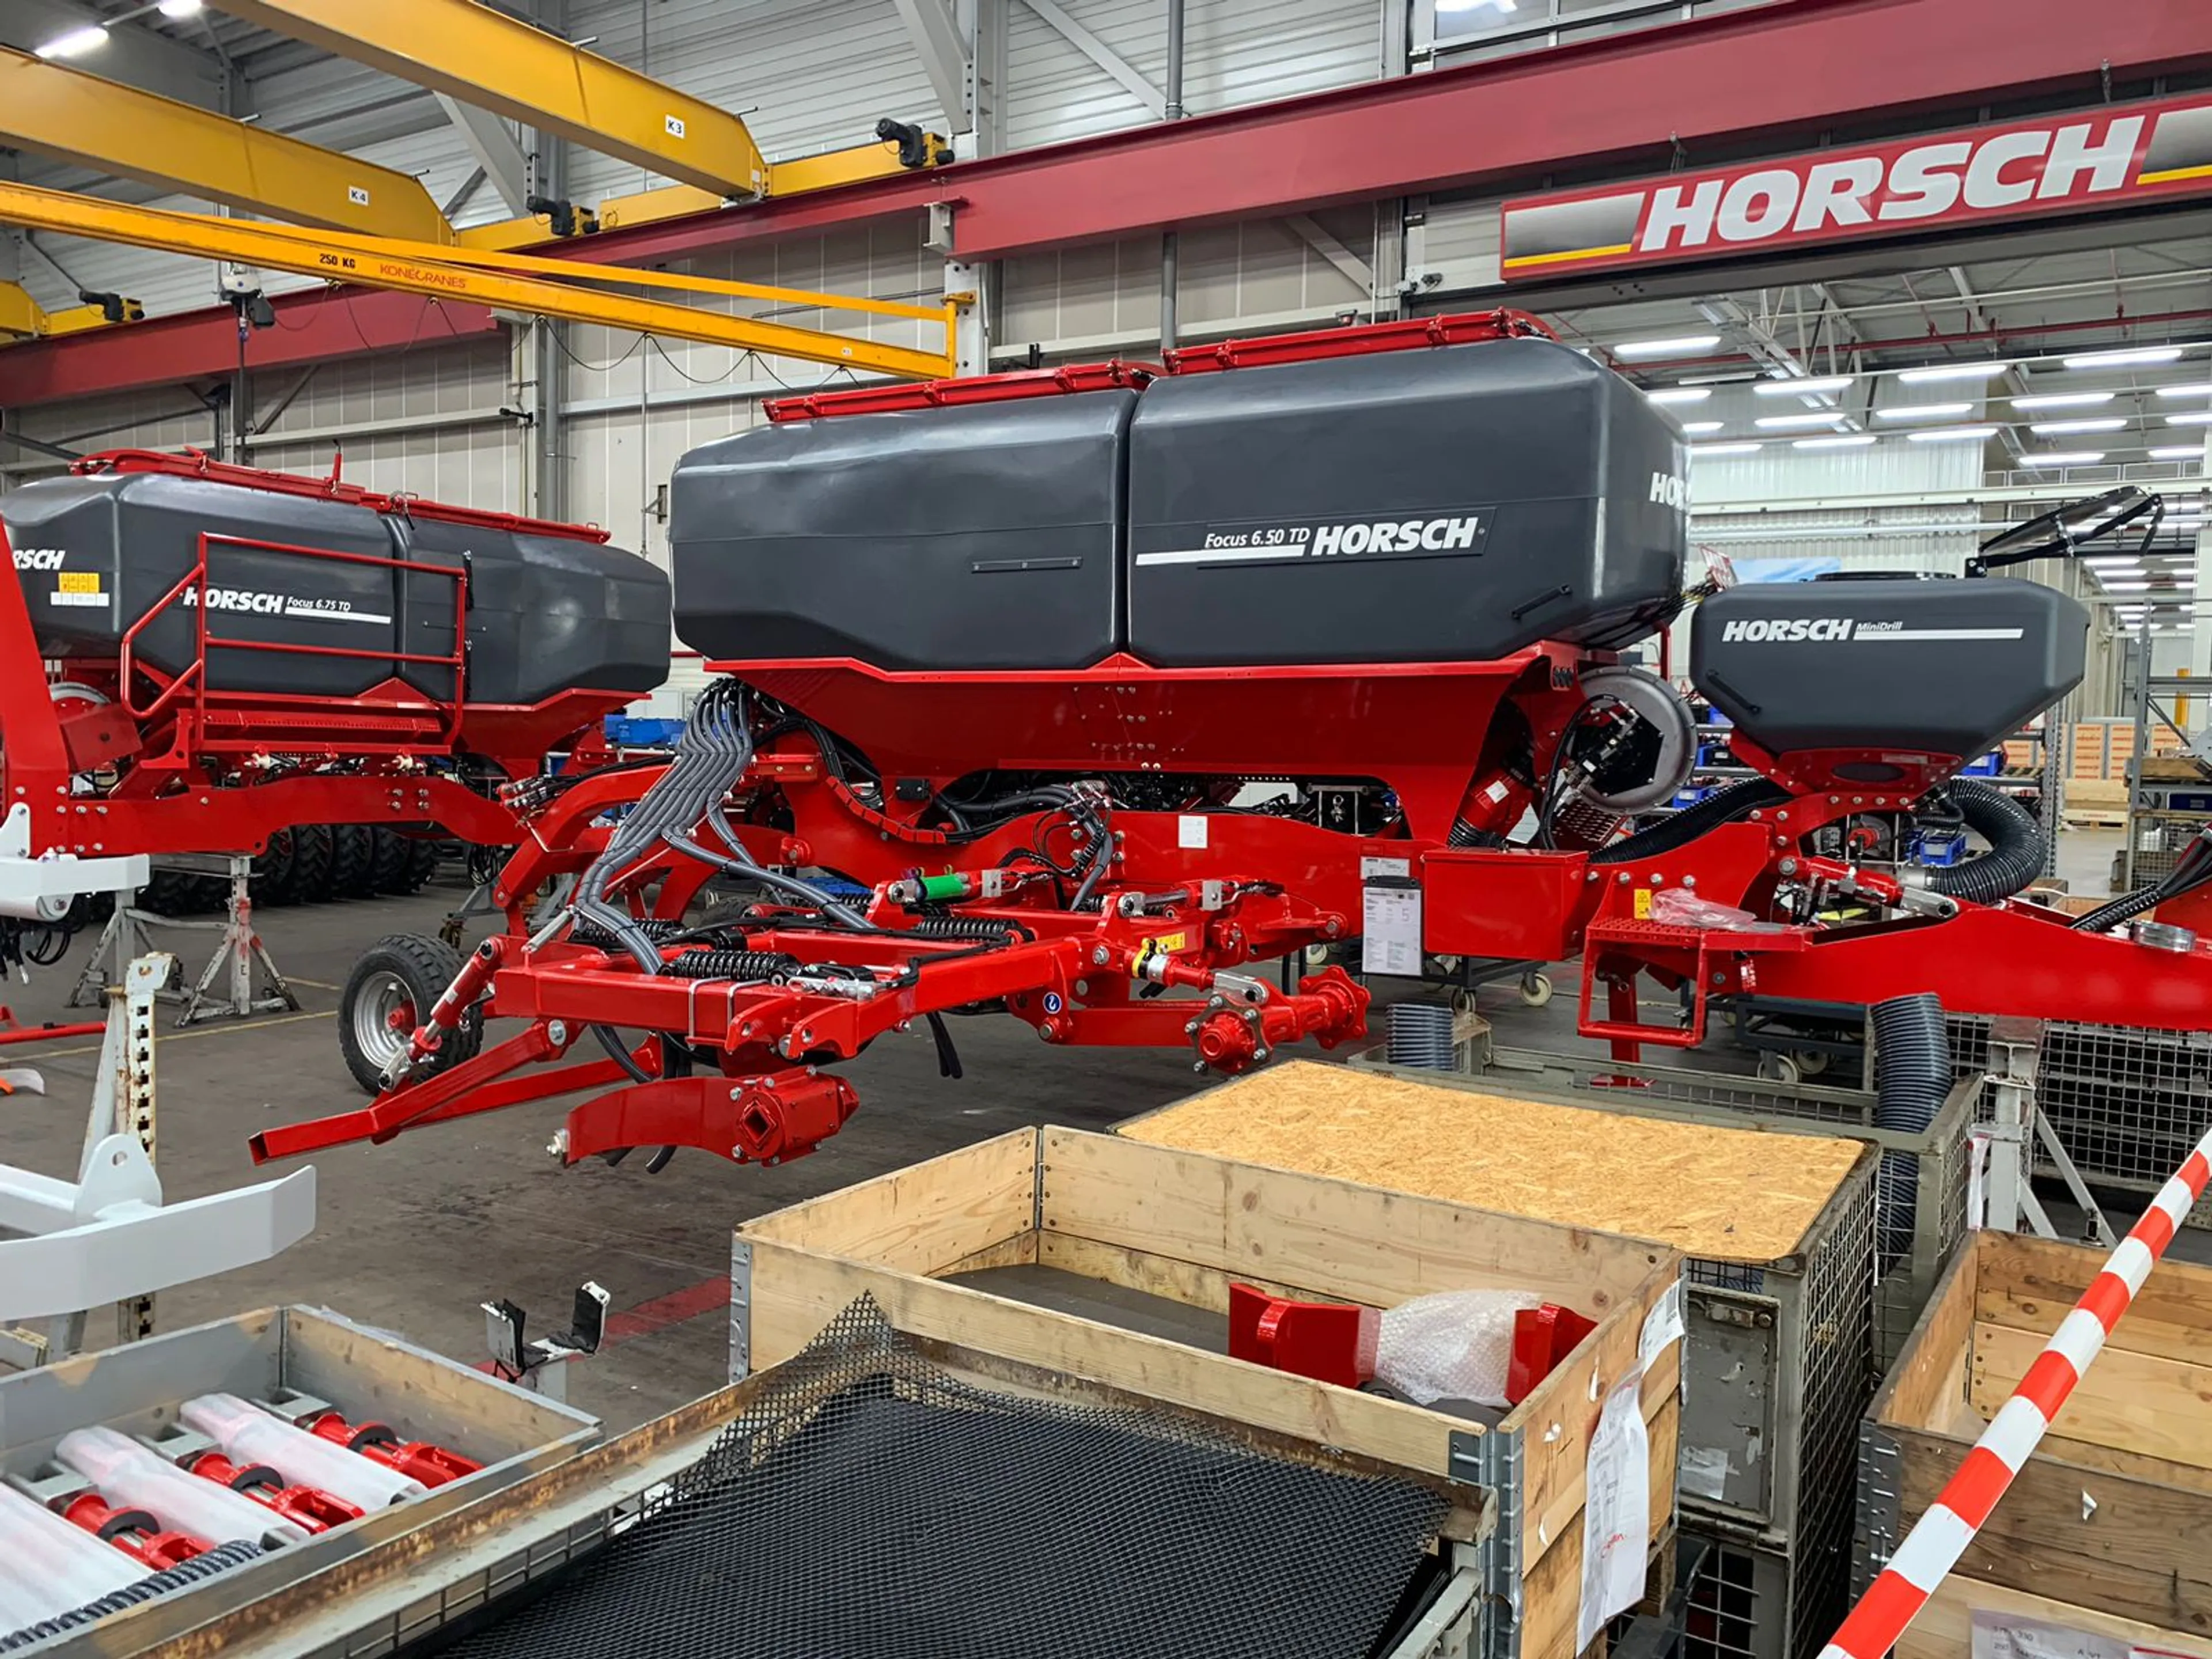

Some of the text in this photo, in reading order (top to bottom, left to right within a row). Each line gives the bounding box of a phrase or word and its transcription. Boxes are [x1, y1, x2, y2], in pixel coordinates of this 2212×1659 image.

[668, 119, 682, 134] K 3
[351, 189, 358, 200] K
[1639, 115, 2146, 252] HORSCH
[320, 253, 355, 268] 250 KG
[380, 263, 466, 289] KONECRANES
[1205, 517, 1479, 556] Focus 6.50 TD HORSCH
[183, 586, 351, 614] HORSCH Focus 6.75 TD
[1722, 618, 1903, 642] HORSCH MiniDrill
